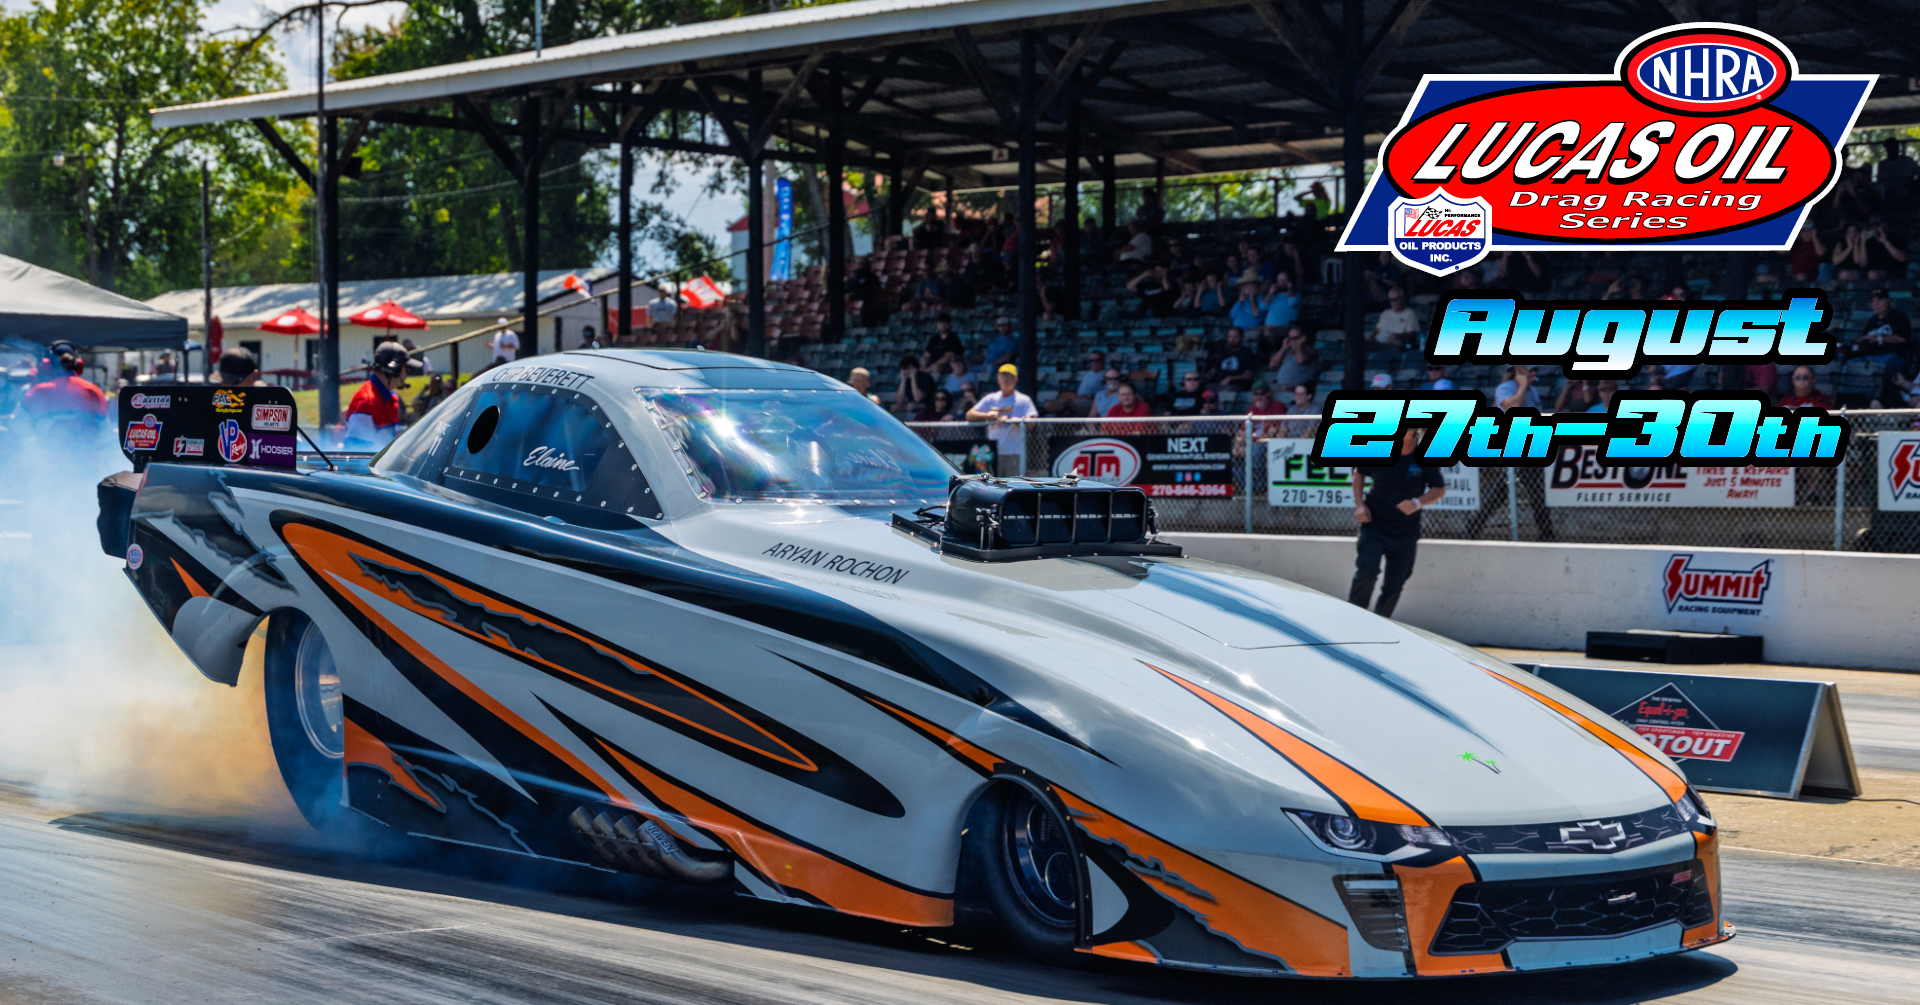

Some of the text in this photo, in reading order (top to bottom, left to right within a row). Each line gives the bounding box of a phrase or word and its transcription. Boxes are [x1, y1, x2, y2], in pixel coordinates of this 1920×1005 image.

[491, 366, 595, 390] CHIP BEVERETT
[255, 408, 288, 422] SIMPSON
[129, 429, 148, 439] LUCAS
[218, 419, 239, 461] VP
[260, 445, 294, 456] HOOSIER
[1167, 437, 1208, 453] NEXT
[523, 446, 580, 471] Elaine
[1072, 450, 1121, 477] ATM
[1703, 476, 1782, 487] JUST 5 MINUTES
[1152, 484, 1226, 496] 270-846-3964
[1726, 488, 1759, 499] AWAY!
[1577, 492, 1672, 502] FLEET SERVICE
[762, 542, 910, 584] ARYAN ROCHON
[1678, 605, 1762, 615] RACING EQUIPMENT
